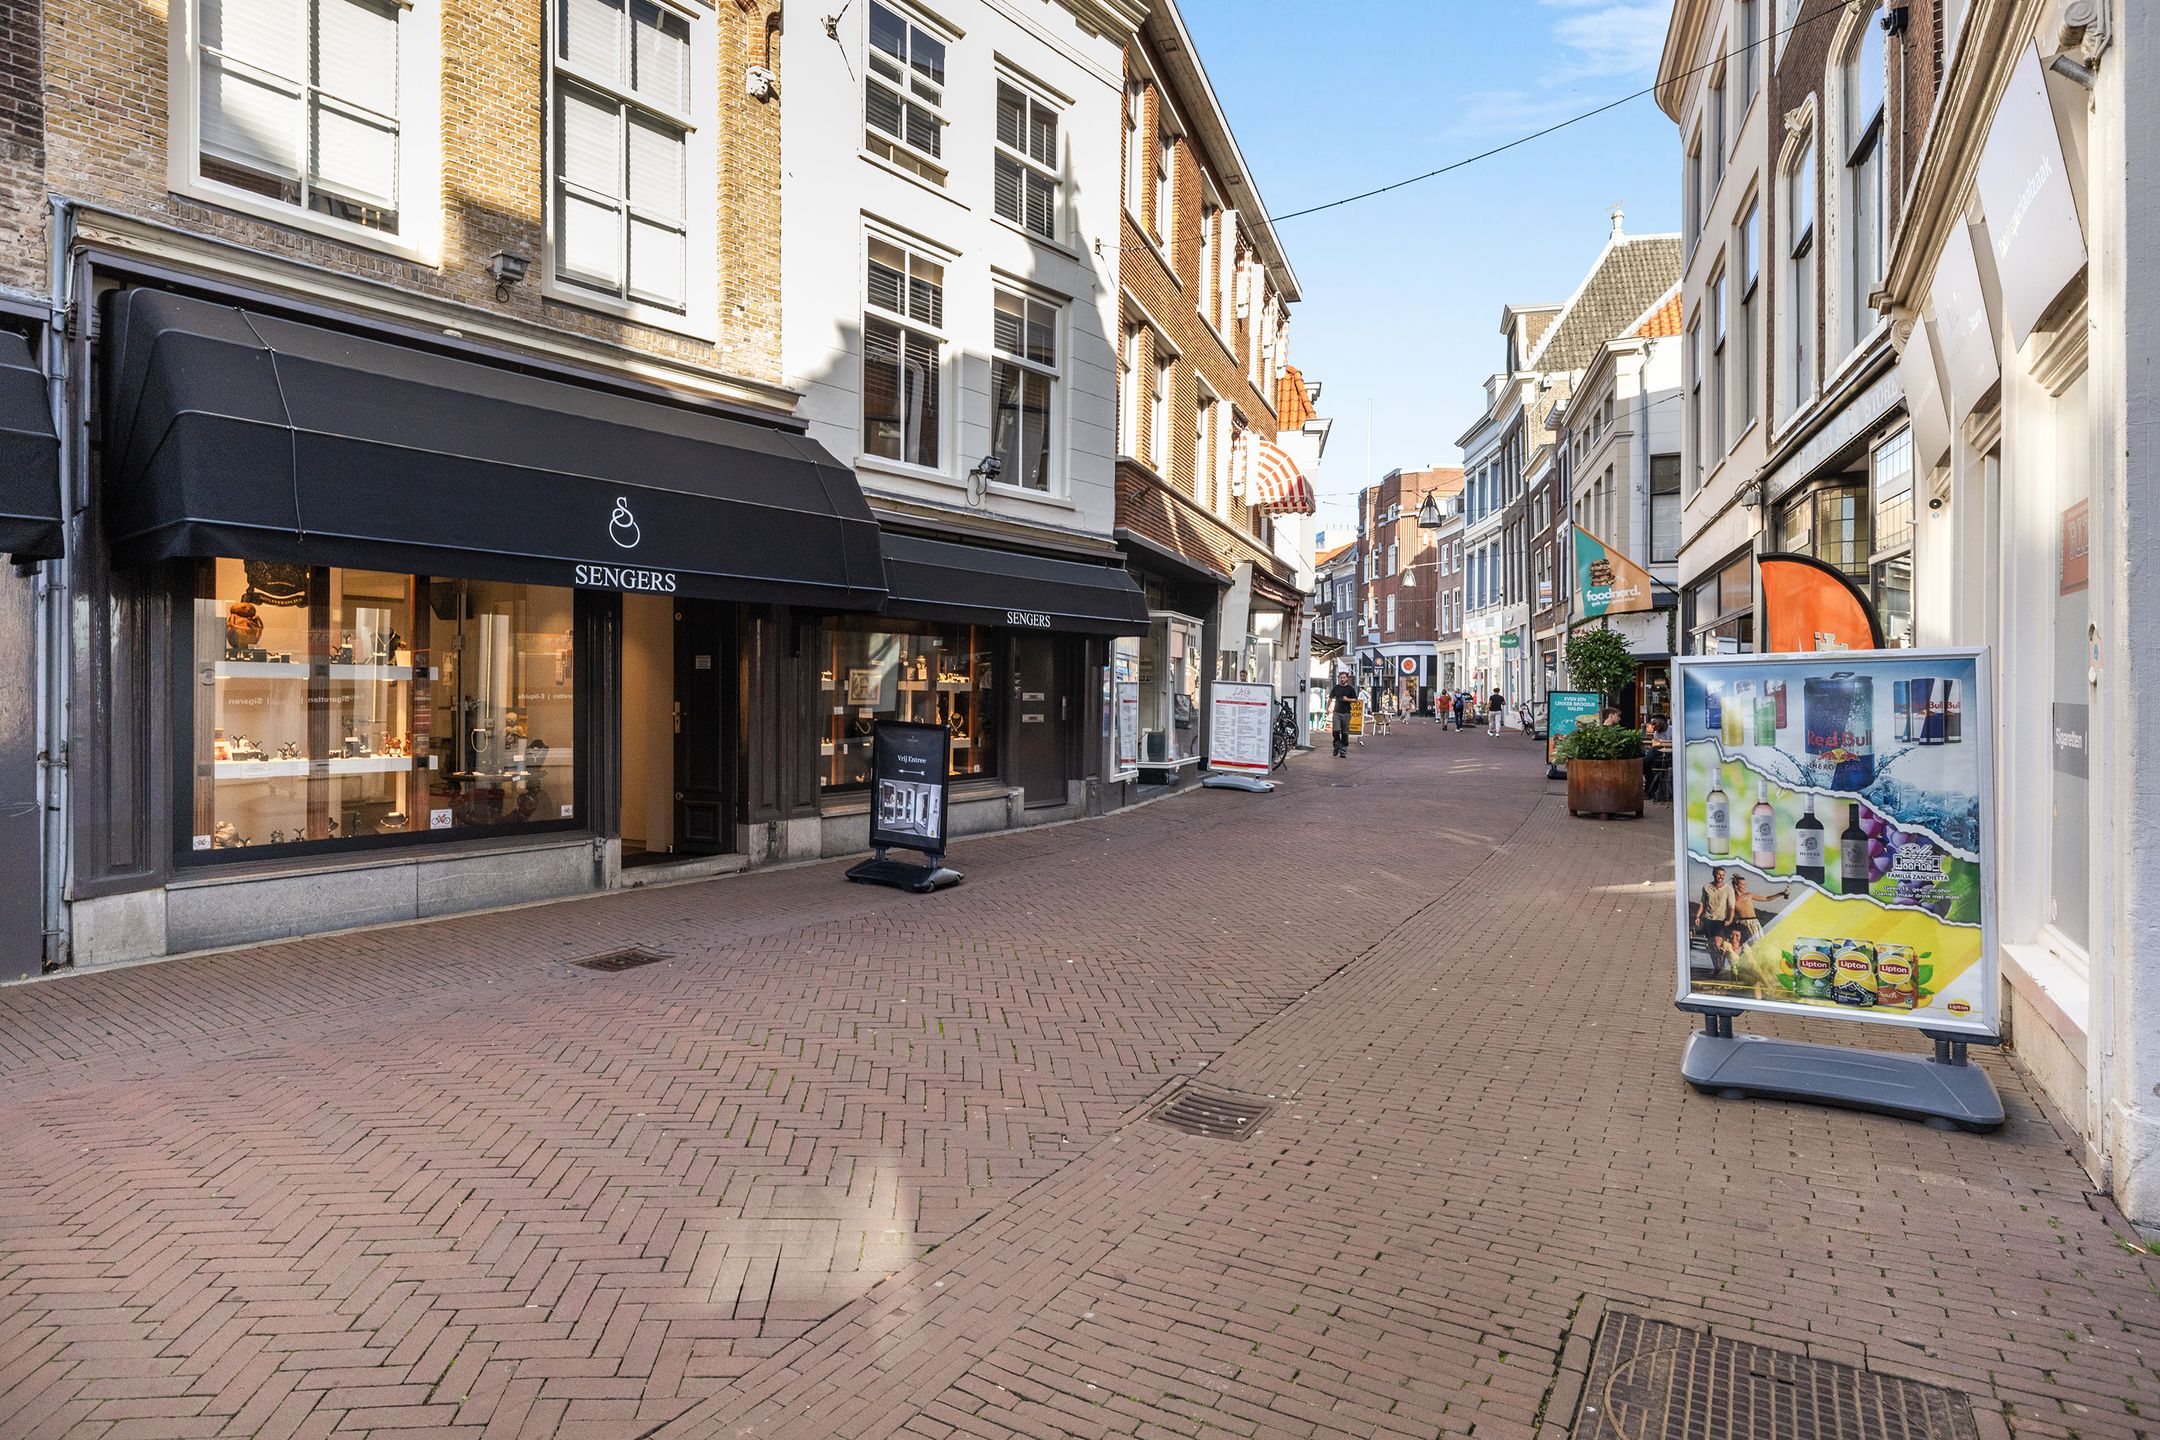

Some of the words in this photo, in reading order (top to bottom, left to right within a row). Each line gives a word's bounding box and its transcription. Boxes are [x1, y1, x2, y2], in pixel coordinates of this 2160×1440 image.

[575, 565, 676, 592] SENGERS
[1007, 611, 1051, 628] SENGERS
[1808, 730, 1838, 747] Red
[1841, 730, 1872, 747] Bull
[2056, 727, 2083, 749] Sigaretten
[897, 755, 908, 763] Vrij
[908, 756, 927, 764] Entree
[1802, 960, 1828, 969] Lipton
[1840, 960, 1867, 970] Lipton
[1881, 965, 1907, 974] Lipton
[1949, 1004, 1969, 1012] Lipton
